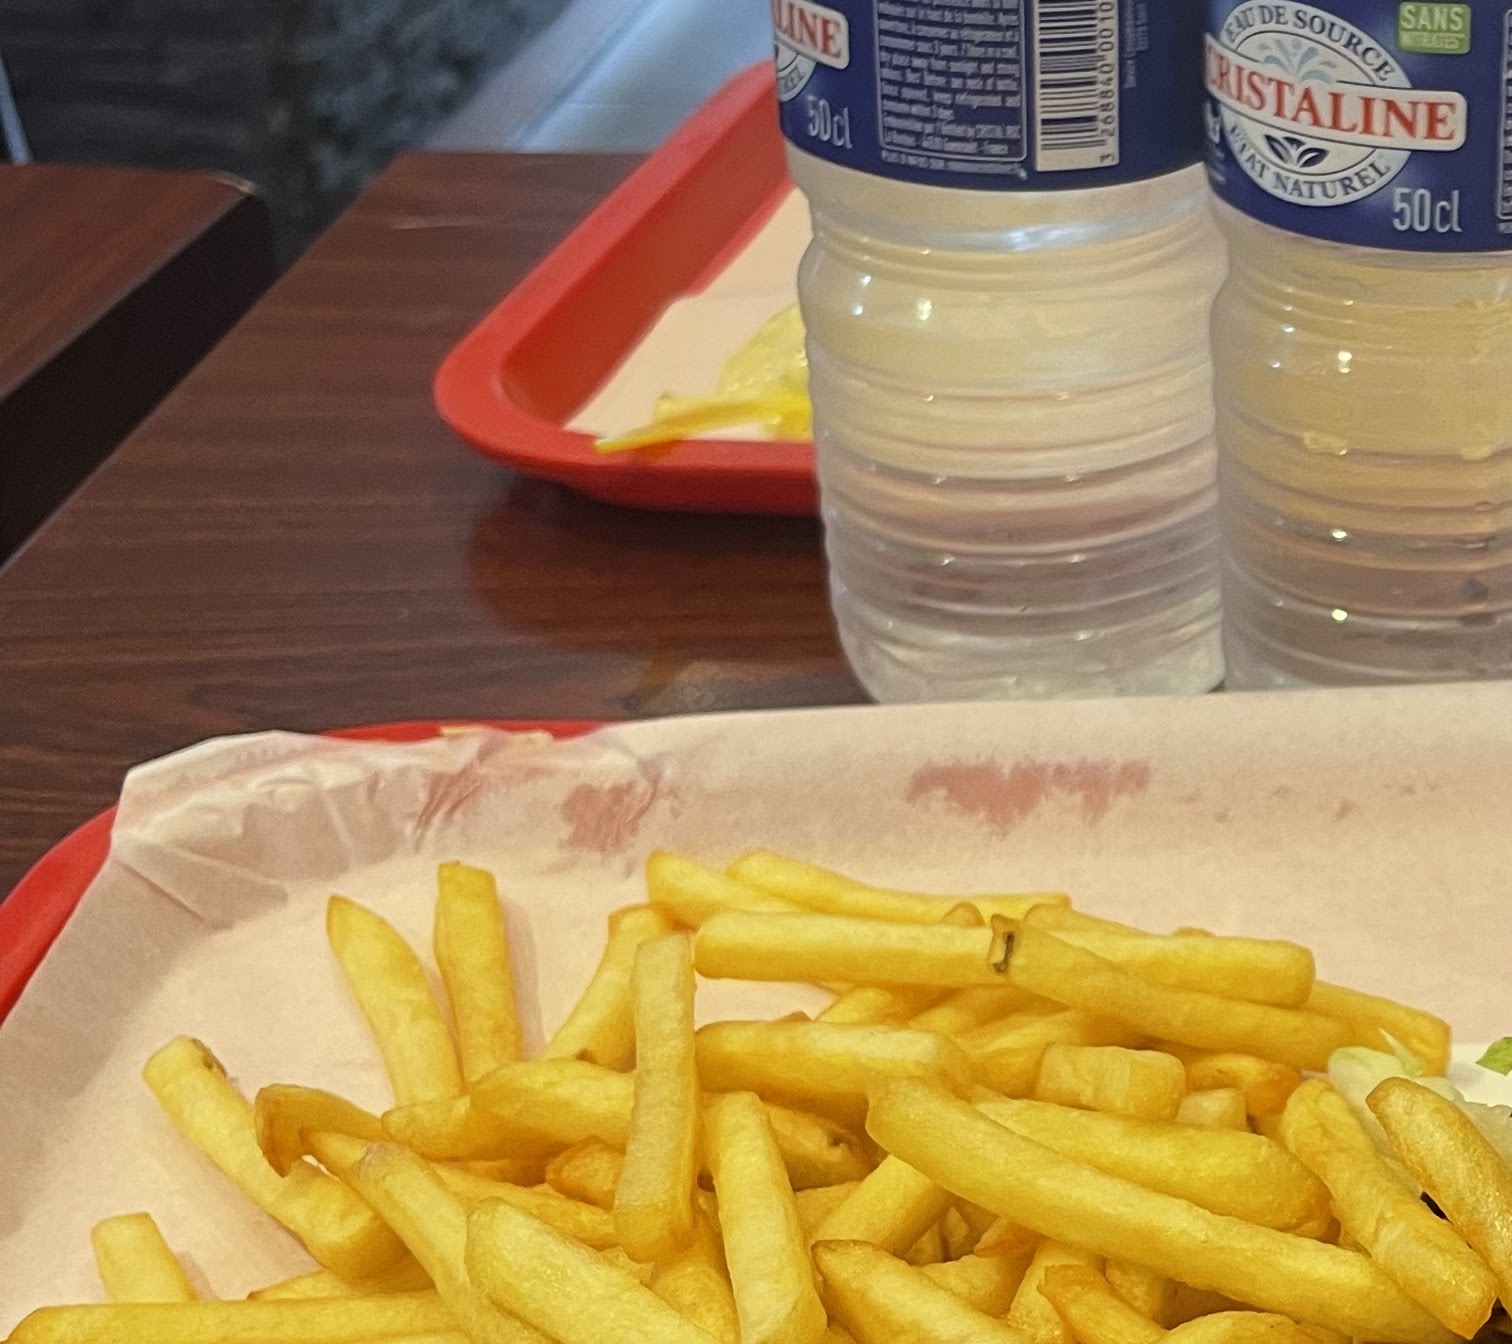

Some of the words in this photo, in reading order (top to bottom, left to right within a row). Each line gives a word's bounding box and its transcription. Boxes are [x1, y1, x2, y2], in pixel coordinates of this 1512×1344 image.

[1401, 4, 1464, 32] SANS
[1258, 5, 1289, 26] DE
[1293, 9, 1396, 82] SOURCE
[807, 95, 853, 149] 50cl
[1096, 62, 1115, 138] 268840
[1272, 159, 1391, 199] NATUREL
[1392, 187, 1464, 233] 50cl
